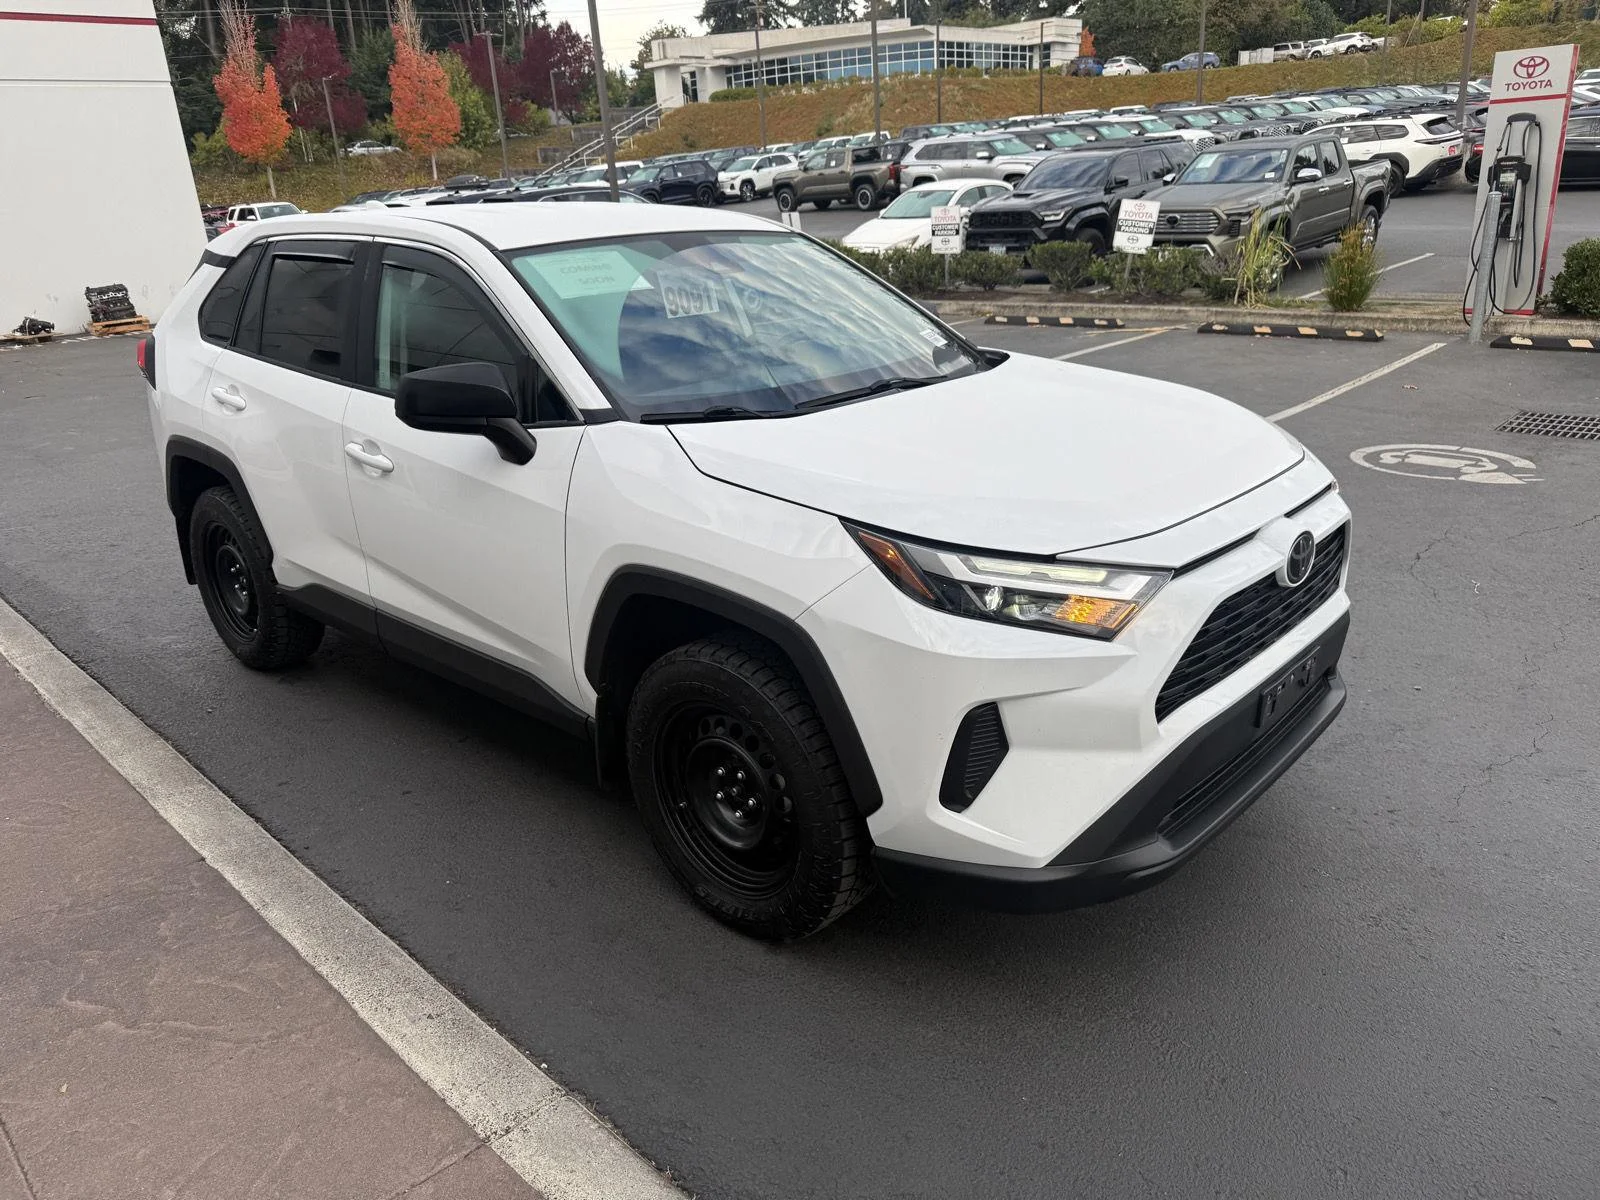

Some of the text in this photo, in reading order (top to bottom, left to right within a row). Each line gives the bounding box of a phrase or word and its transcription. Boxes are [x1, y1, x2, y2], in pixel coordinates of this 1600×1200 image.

[1504, 79, 1553, 92] TOYOTA
[934, 215, 957, 223] TOYOTA
[1123, 209, 1153, 219] TOYOTA
[1118, 219, 1154, 229] CUSTOMER
[1120, 226, 1150, 234] PARKING
[560, 263, 613, 274] COMING
